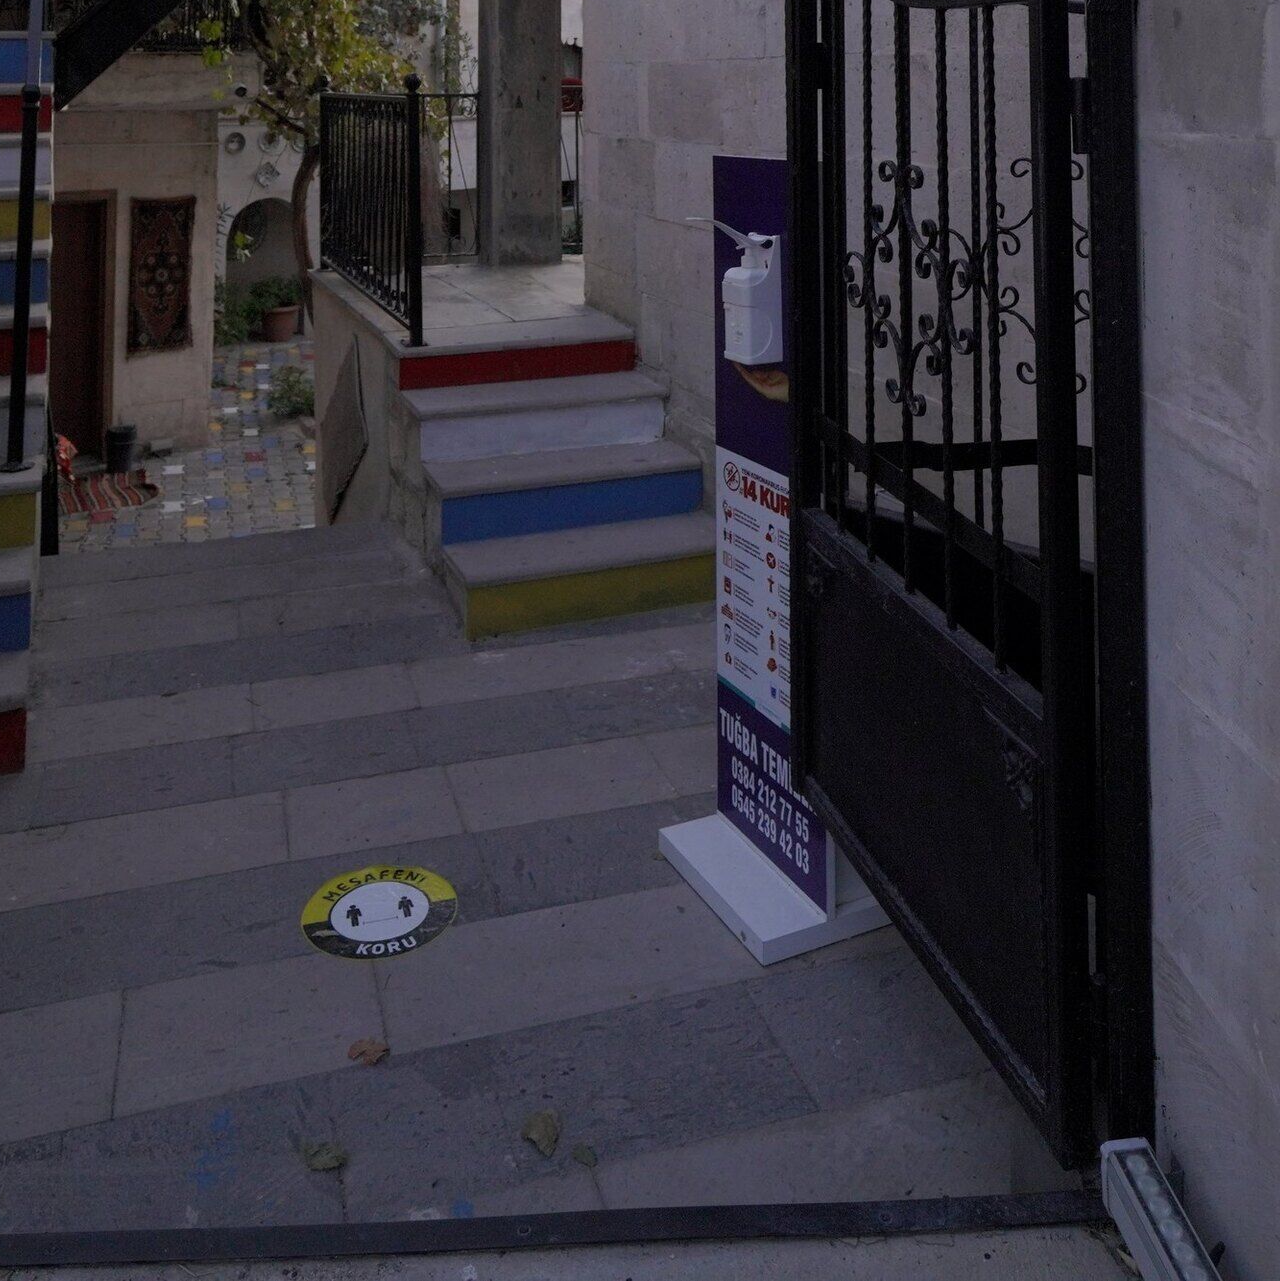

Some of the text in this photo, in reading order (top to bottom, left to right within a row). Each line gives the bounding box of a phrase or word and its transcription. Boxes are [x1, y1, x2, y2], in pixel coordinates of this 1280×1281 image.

[719, 707, 758, 765] TUĞBA
[732, 756, 809, 843] 0384 212 77 55
[732, 784, 809, 874] 0545 239 42 03
[356, 936, 417, 955] KORU
